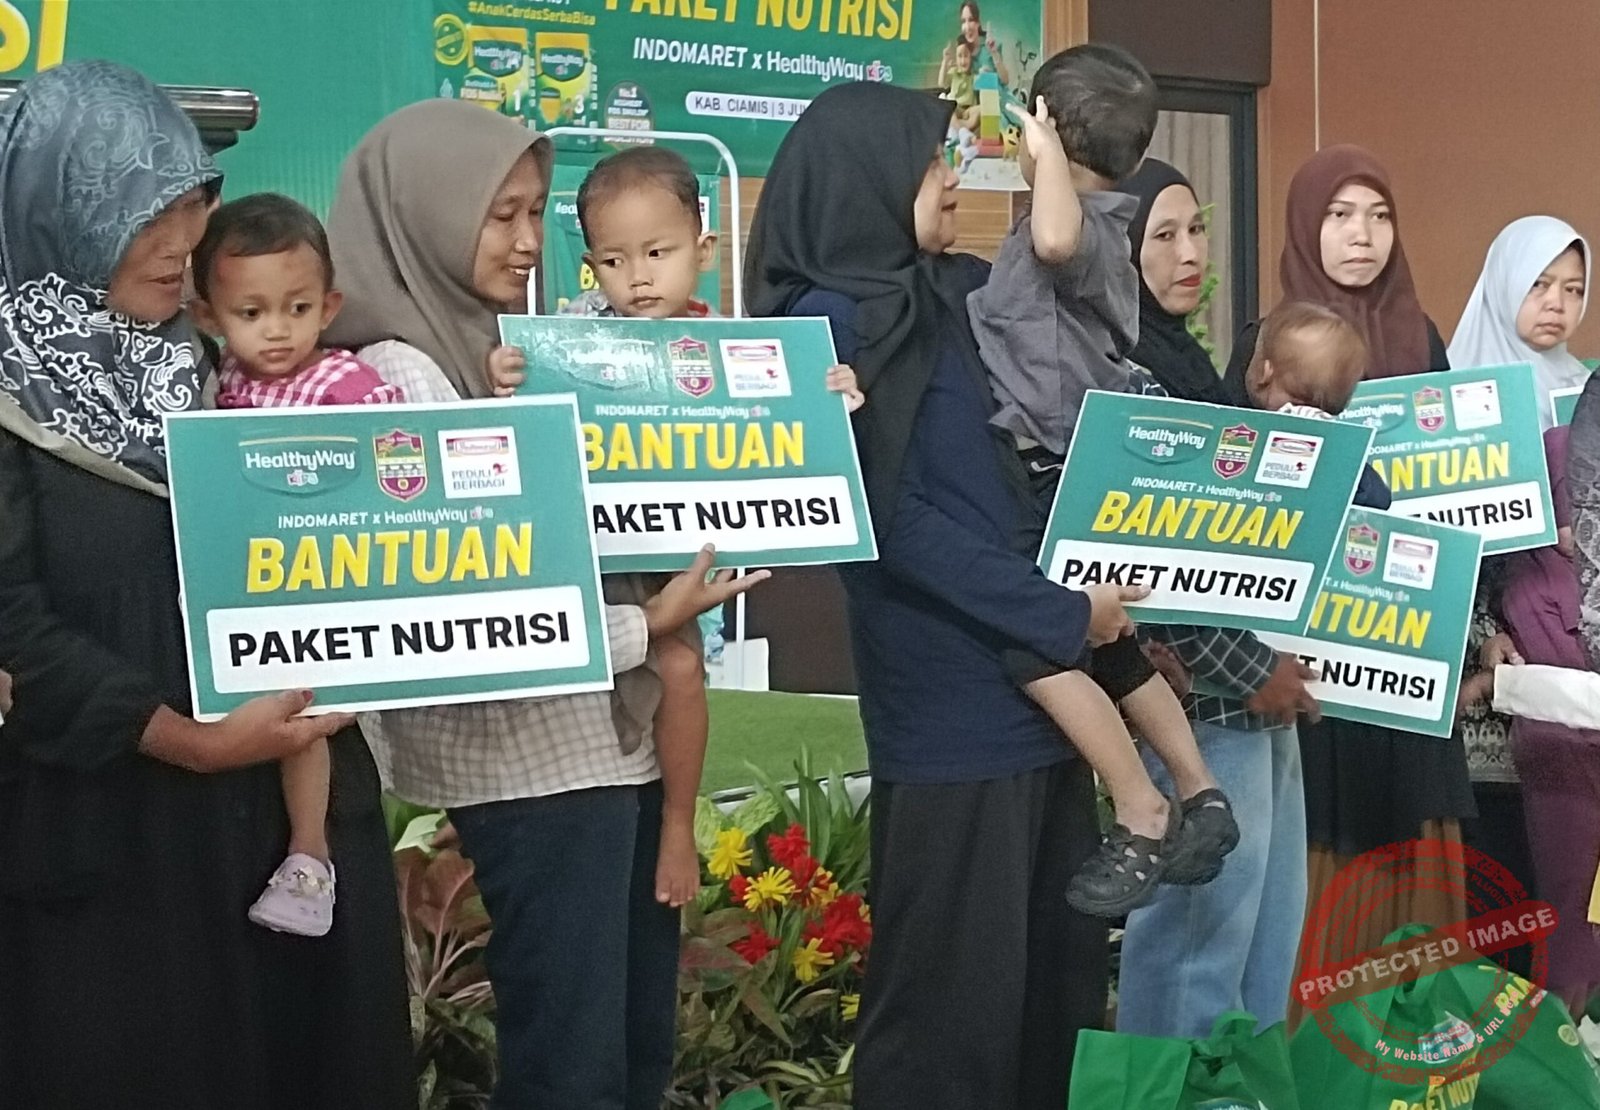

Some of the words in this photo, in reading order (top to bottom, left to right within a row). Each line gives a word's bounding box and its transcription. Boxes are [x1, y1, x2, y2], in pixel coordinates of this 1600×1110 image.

[633, 37, 748, 68] INDOMARET
[752, 53, 763, 70] x
[767, 50, 864, 82] HealthyWay
[695, 96, 724, 111] KAB.
[727, 98, 768, 114] CIAMIS
[778, 103, 785, 115] 3
[595, 404, 669, 417] INDOMARET
[681, 406, 750, 419] HealthyWay
[581, 421, 804, 471] BANTUAN
[1128, 425, 1206, 449] HealthyWay
[1368, 442, 1413, 455] DOMARET
[245, 449, 356, 471] HealthyWay
[1371, 441, 1509, 492] ANTUAN
[1131, 476, 1197, 493] INDOMARET
[1205, 485, 1264, 503] HealthyWay
[278, 512, 369, 529] INDOMARET
[385, 507, 468, 525] HealthyWay
[592, 502, 686, 534] AKET
[695, 497, 842, 530] NUTRISI
[1091, 490, 1304, 550] BANTUAN
[246, 522, 533, 593] BANTUAN
[1061, 559, 1169, 590] PAKET
[1170, 567, 1298, 602] NUTRISI
[228, 624, 380, 667] PAKET
[390, 611, 570, 656] NUTRISI
[1320, 659, 1436, 701] NUTRISI
